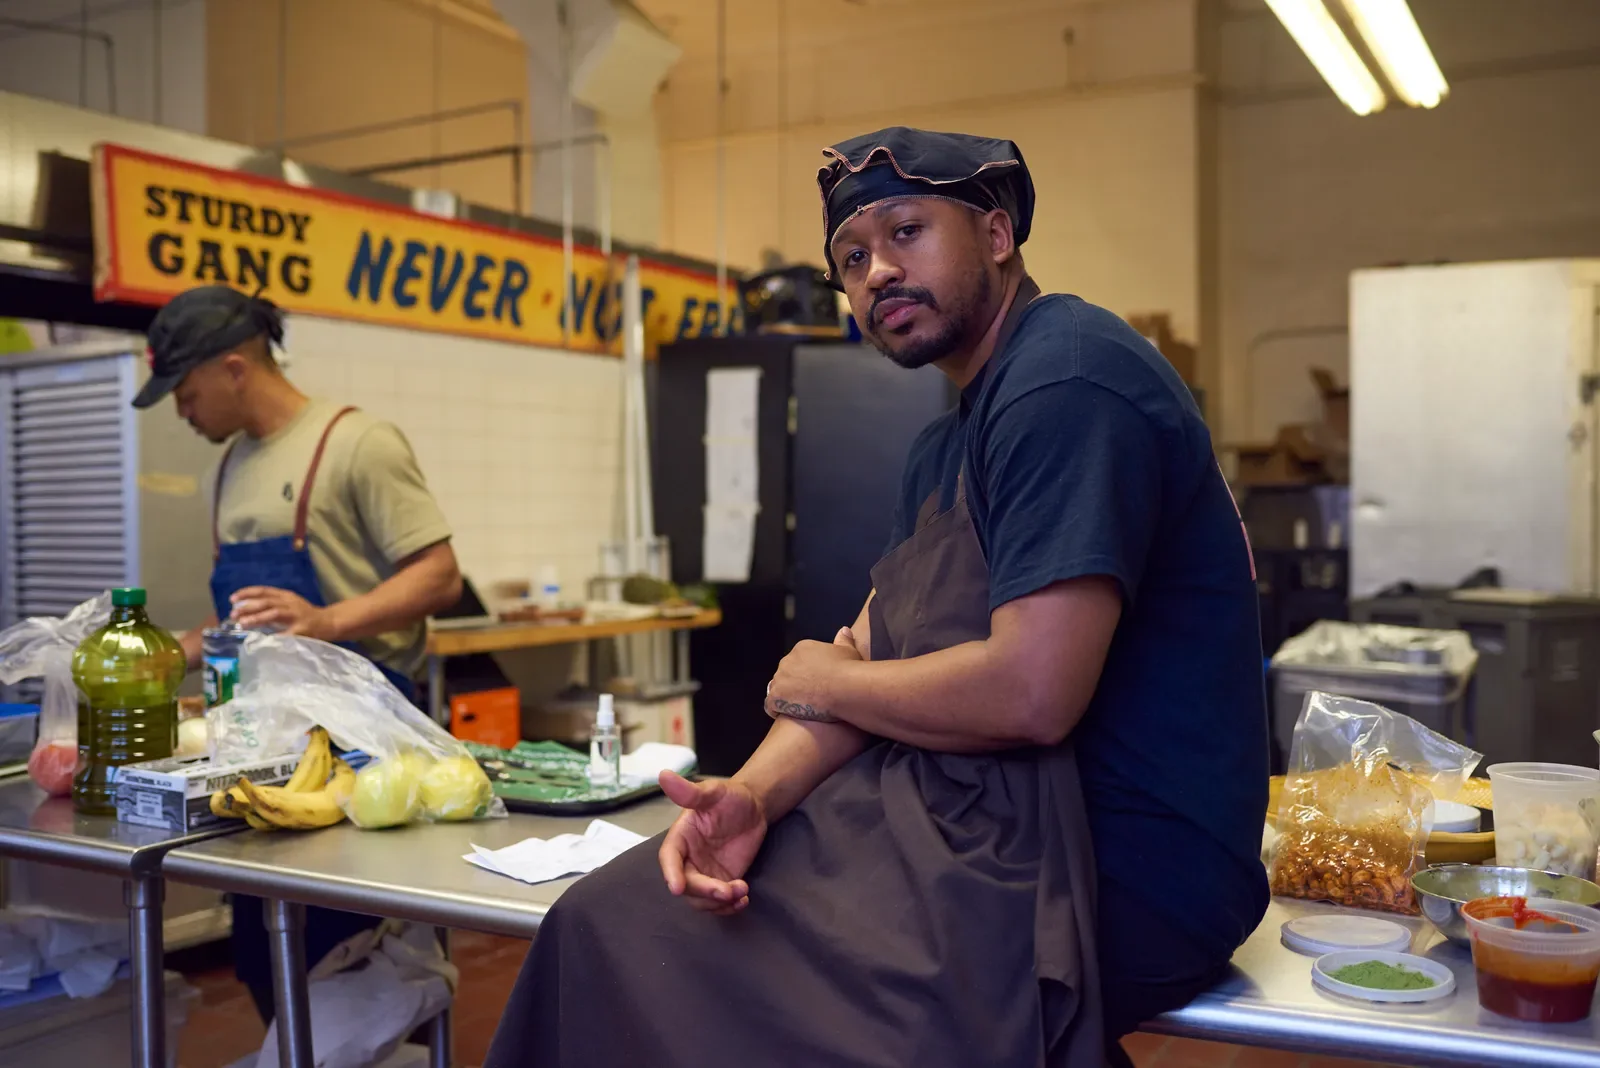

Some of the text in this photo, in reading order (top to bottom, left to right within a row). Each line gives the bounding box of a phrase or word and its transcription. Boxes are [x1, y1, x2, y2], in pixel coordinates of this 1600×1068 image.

[144, 183, 313, 243] STURDY
[147, 232, 312, 293] GANG
[346, 230, 530, 327] NEVER
